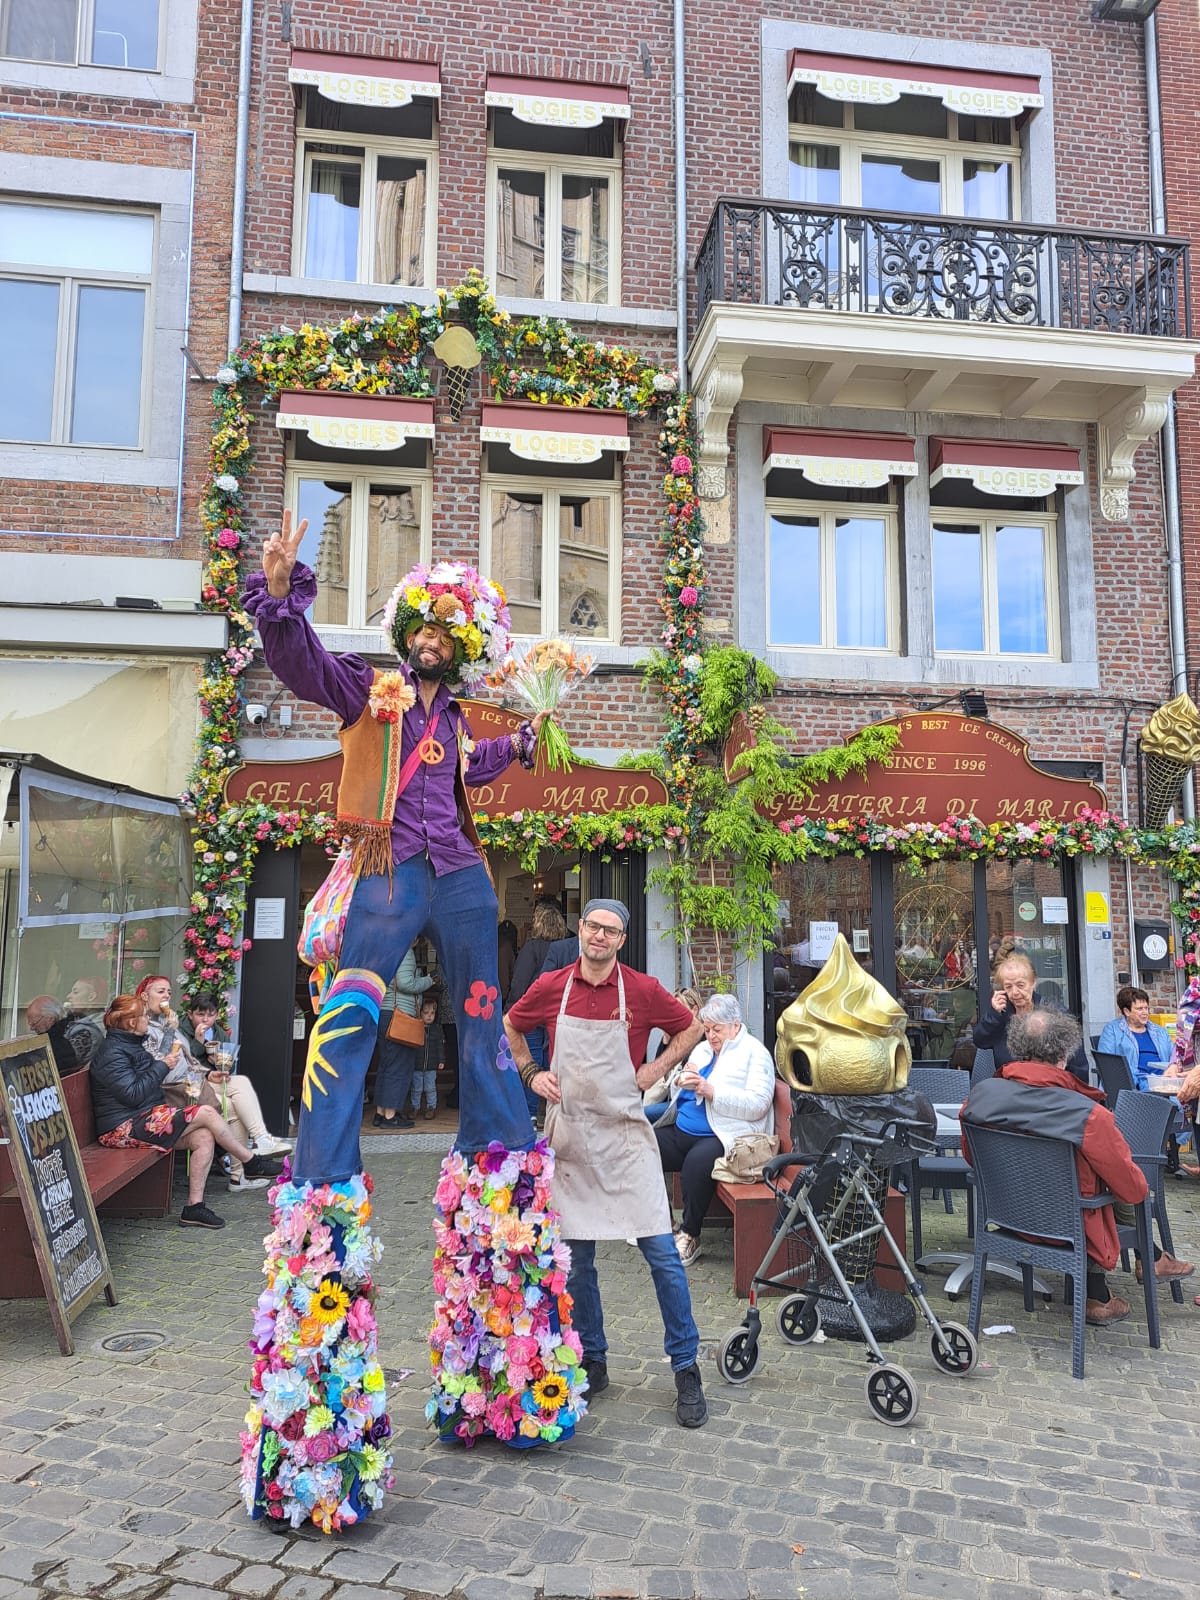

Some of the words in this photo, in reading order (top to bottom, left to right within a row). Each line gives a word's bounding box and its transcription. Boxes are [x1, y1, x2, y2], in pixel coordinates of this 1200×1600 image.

[324, 75, 406, 100] LOGIES
[821, 77, 894, 98] LOGIES
[519, 98, 598, 121] LOGIES
[947, 89, 1018, 111] LOGIES
[313, 421, 399, 443] LOGIES
[516, 433, 596, 456] LOGIES
[808, 461, 883, 481] LOGIES
[977, 469, 1051, 489] LOGIES
[480, 710, 503, 725] ICE
[921, 720, 949, 730] BEST
[959, 722, 980, 735] ICE
[985, 730, 1022, 757] CREAM
[885, 756, 937, 770] SINCE
[953, 758, 986, 771] 1996
[245, 780, 335, 806] GELA
[470, 783, 511, 806] DI
[542, 785, 649, 812] MARIO
[769, 793, 927, 817] GELATERIA
[946, 797, 978, 816] DI
[996, 798, 1089, 819] MARIO
[10, 1060, 54, 1096] VERSE
[18, 1085, 62, 1124] LEKKERE
